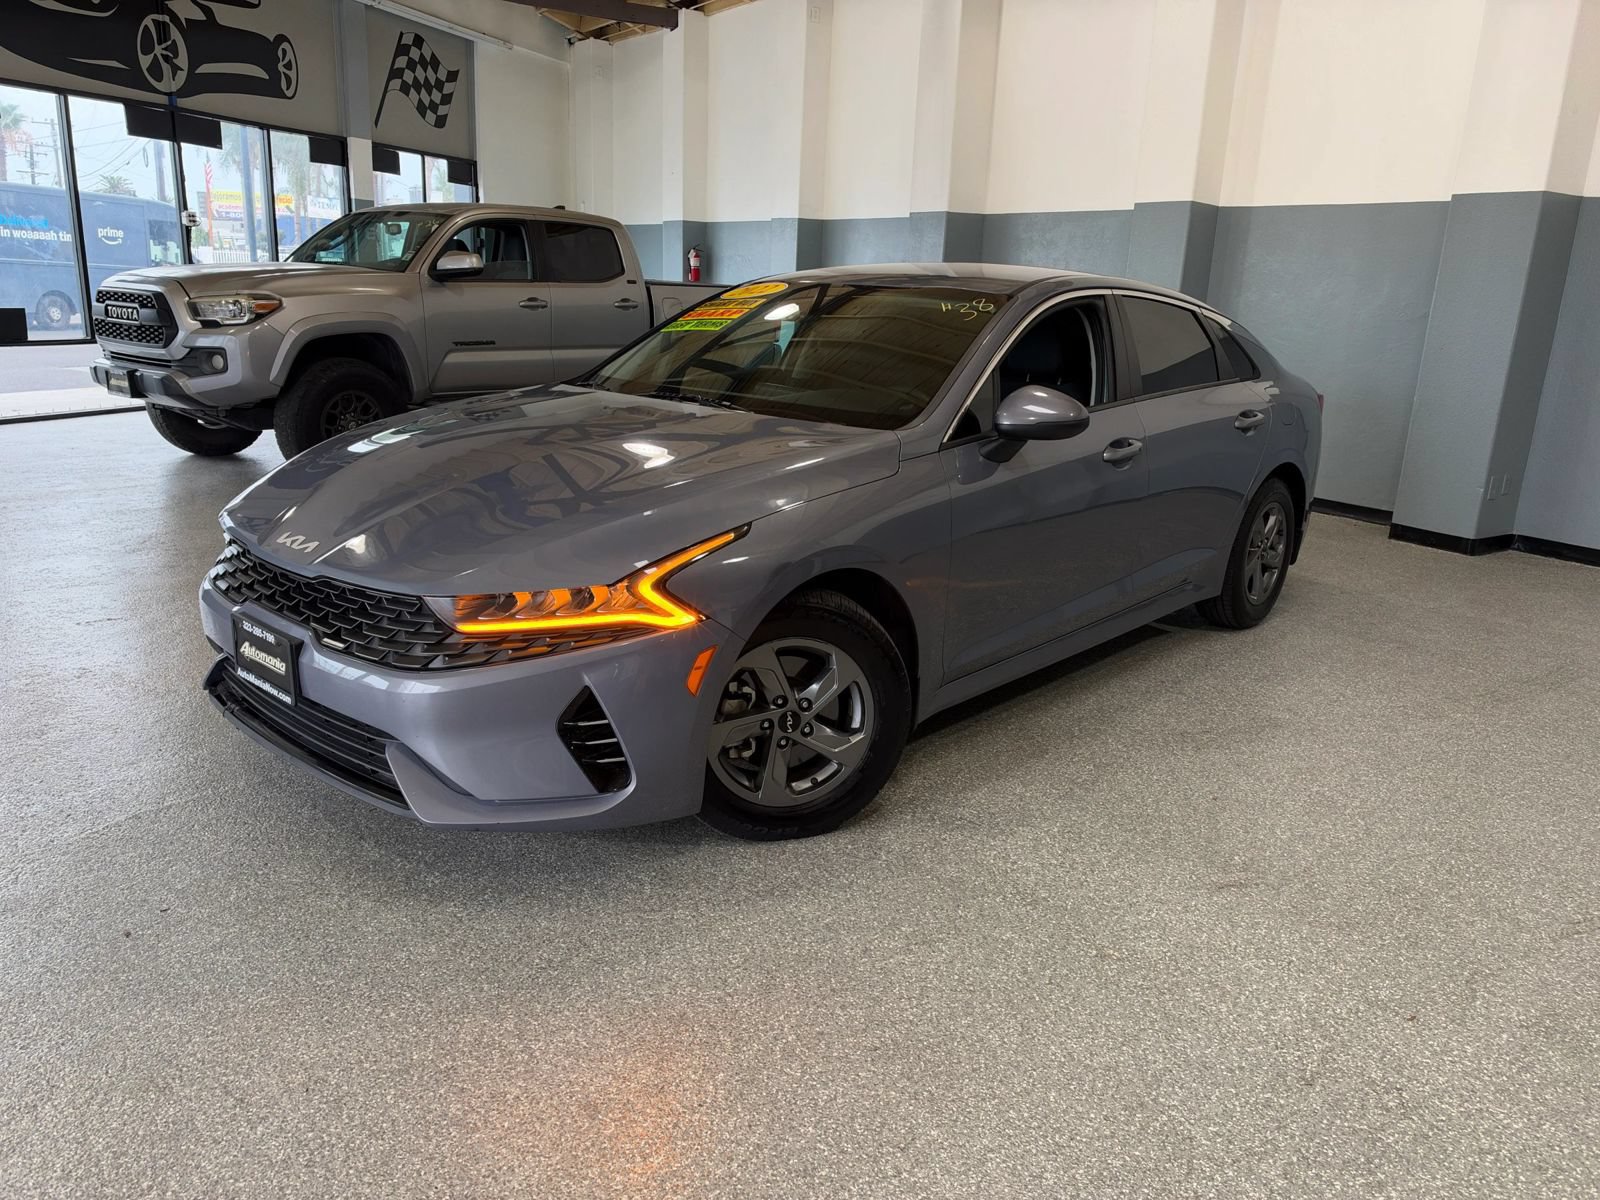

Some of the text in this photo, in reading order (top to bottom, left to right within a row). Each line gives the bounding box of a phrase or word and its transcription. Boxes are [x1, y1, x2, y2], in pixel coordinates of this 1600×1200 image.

[12, 229, 57, 240] woaaaah
[98, 227, 124, 238] prime
[107, 306, 139, 320] TOYOTA
[683, 309, 746, 318] SHARP
[276, 532, 319, 553] KIA
[240, 641, 286, 672] Automania
[237, 667, 292, 705] AutoManiaNow.com
